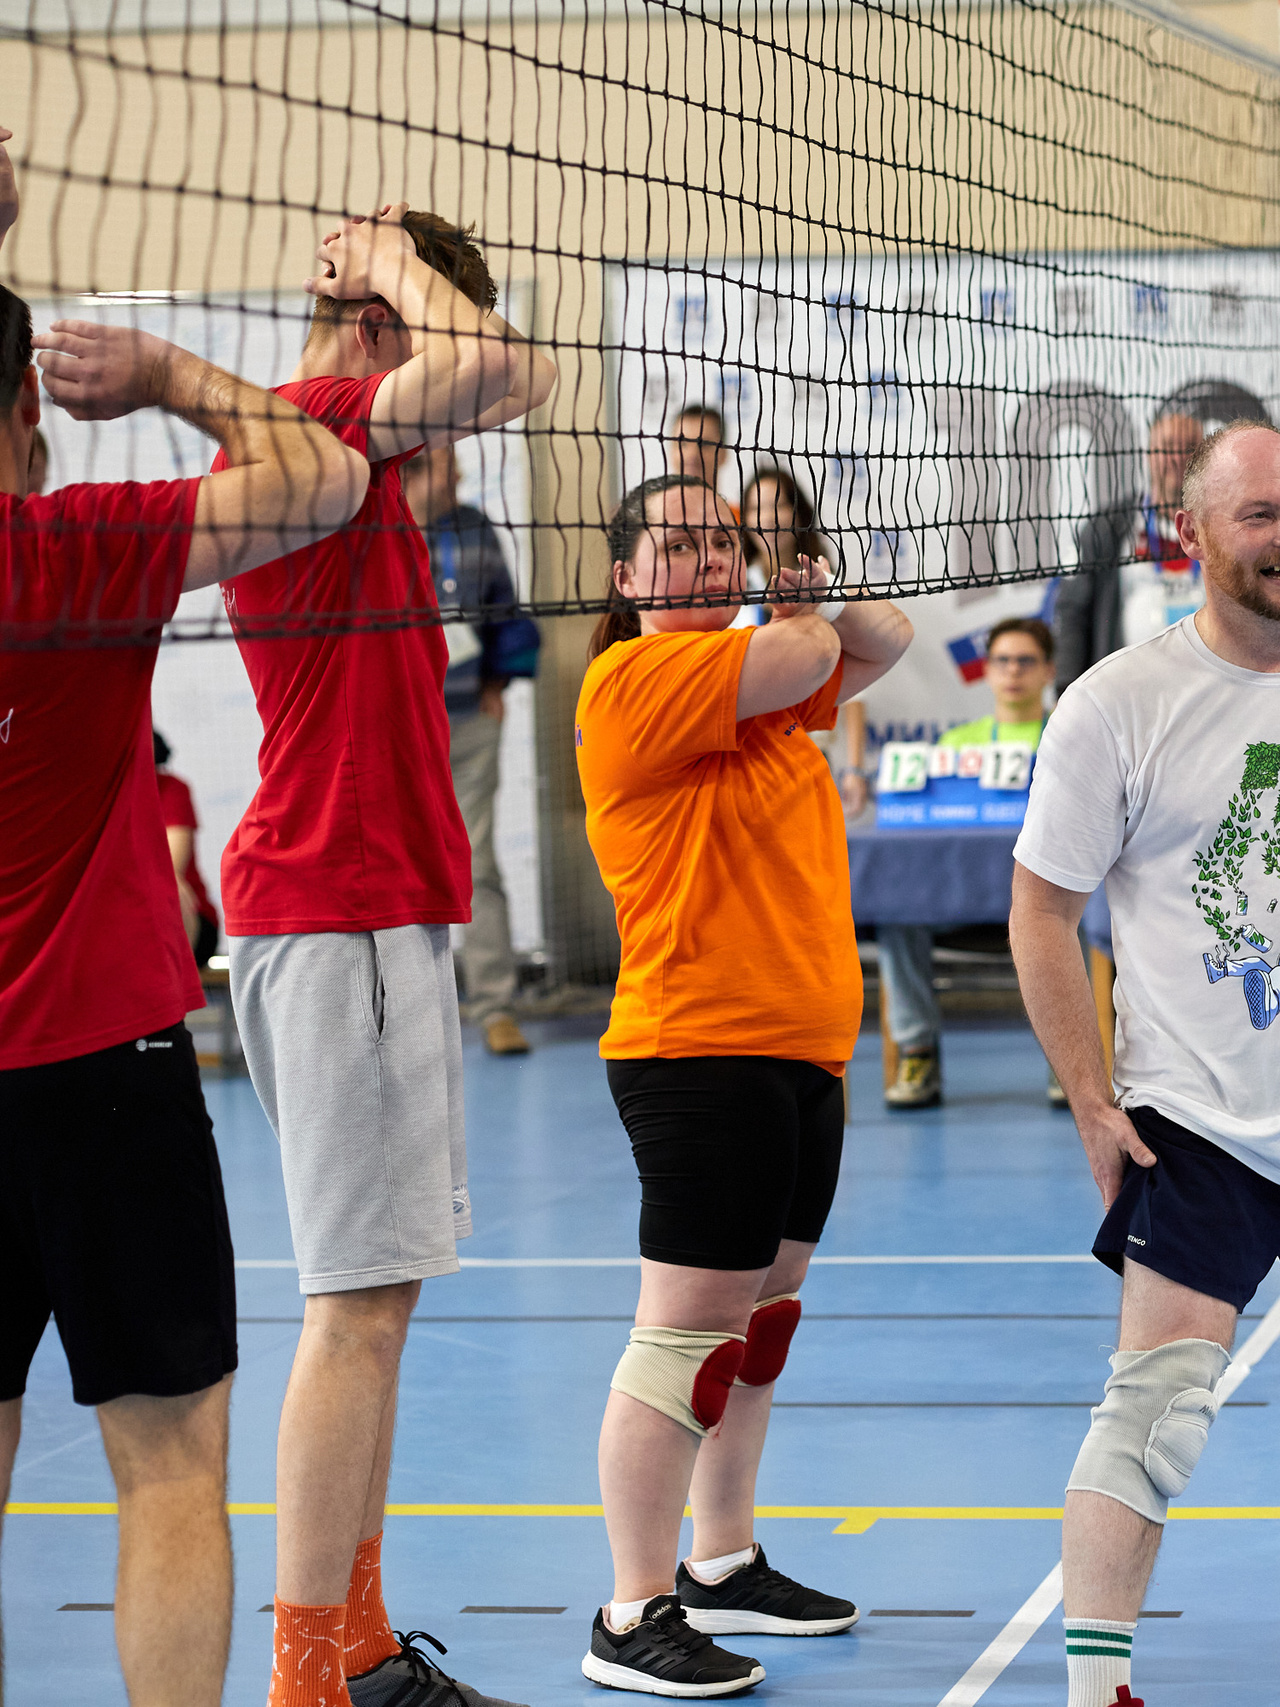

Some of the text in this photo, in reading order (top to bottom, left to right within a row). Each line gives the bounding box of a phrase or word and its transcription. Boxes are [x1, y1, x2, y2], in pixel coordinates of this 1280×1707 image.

[890, 751, 925, 787] 12
[994, 751, 1025, 783] 12
[651, 1603, 672, 1619] adidas
